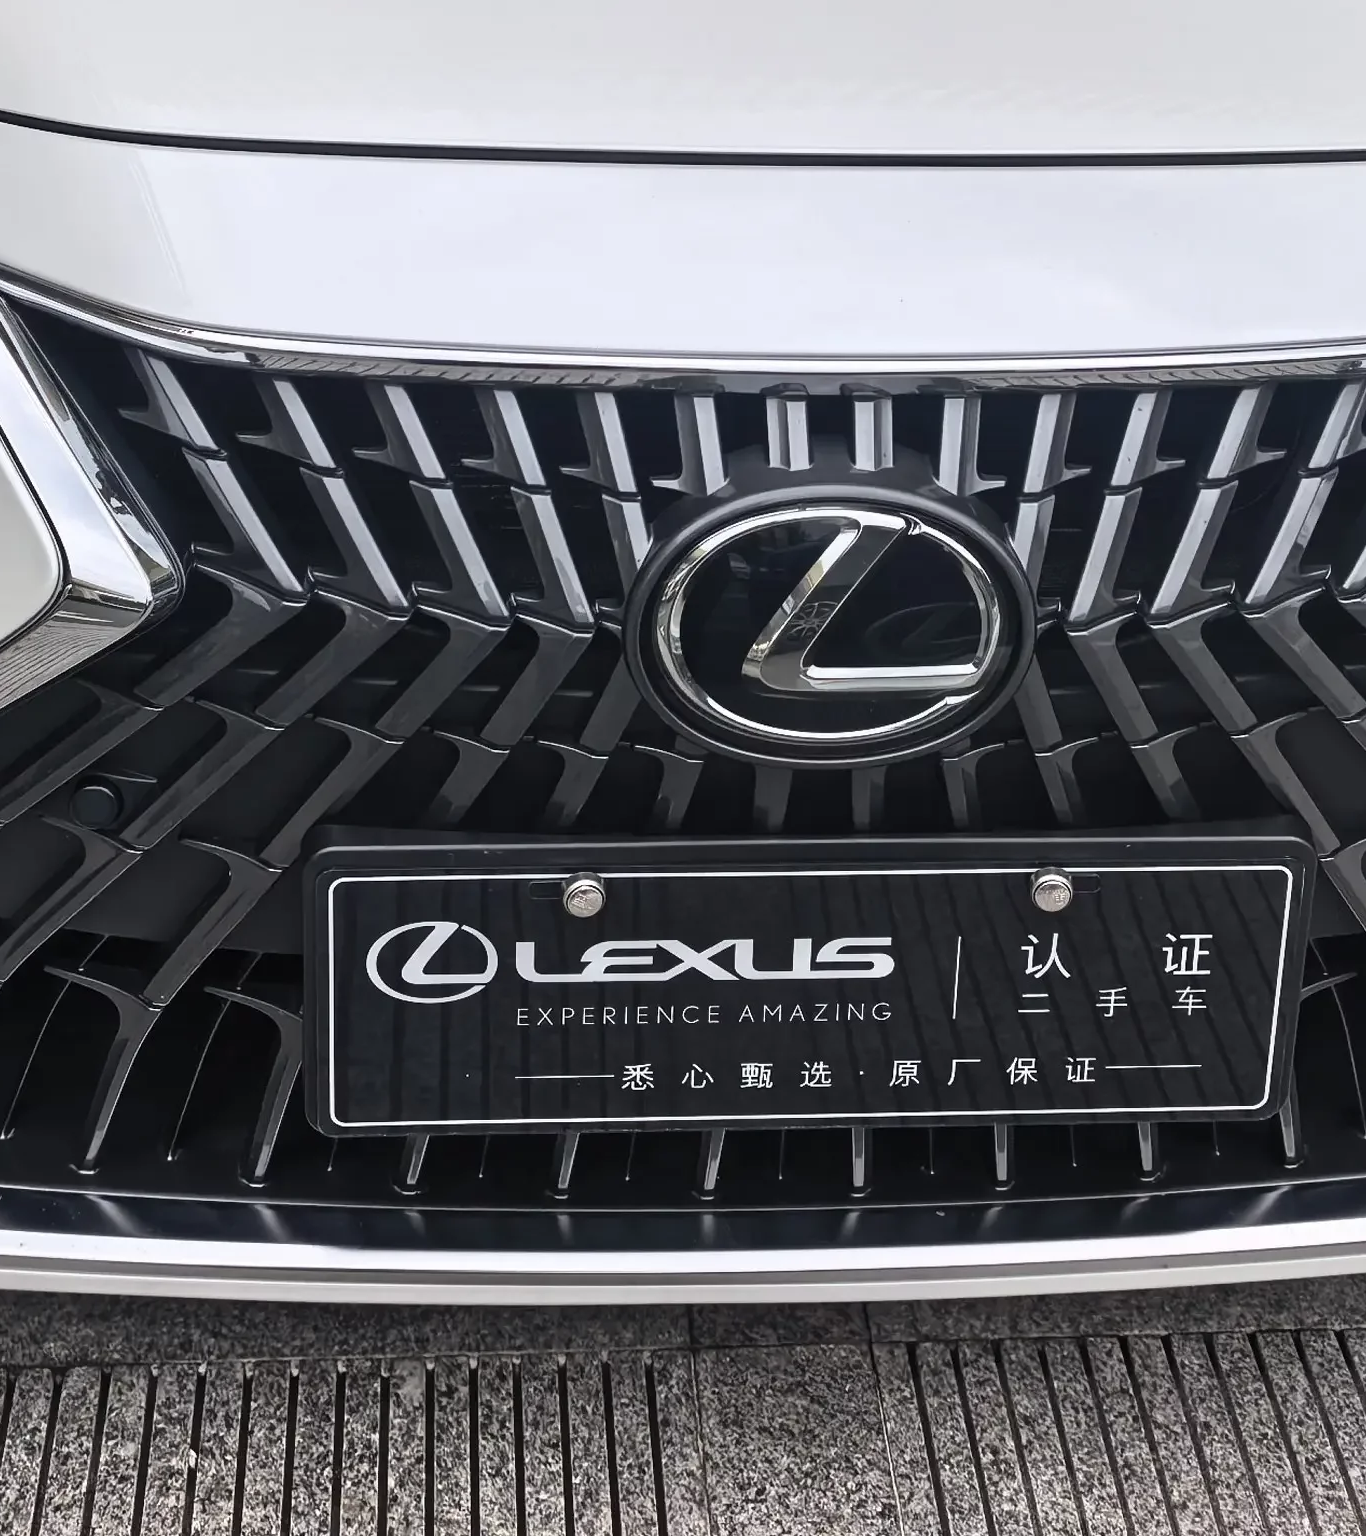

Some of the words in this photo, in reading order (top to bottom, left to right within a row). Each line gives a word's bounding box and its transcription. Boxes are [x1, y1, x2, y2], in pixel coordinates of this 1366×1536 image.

[516, 937, 896, 982] LEXUS
[516, 1005, 720, 1026] EXPERIENCE
[738, 1001, 892, 1023] AMAZING
